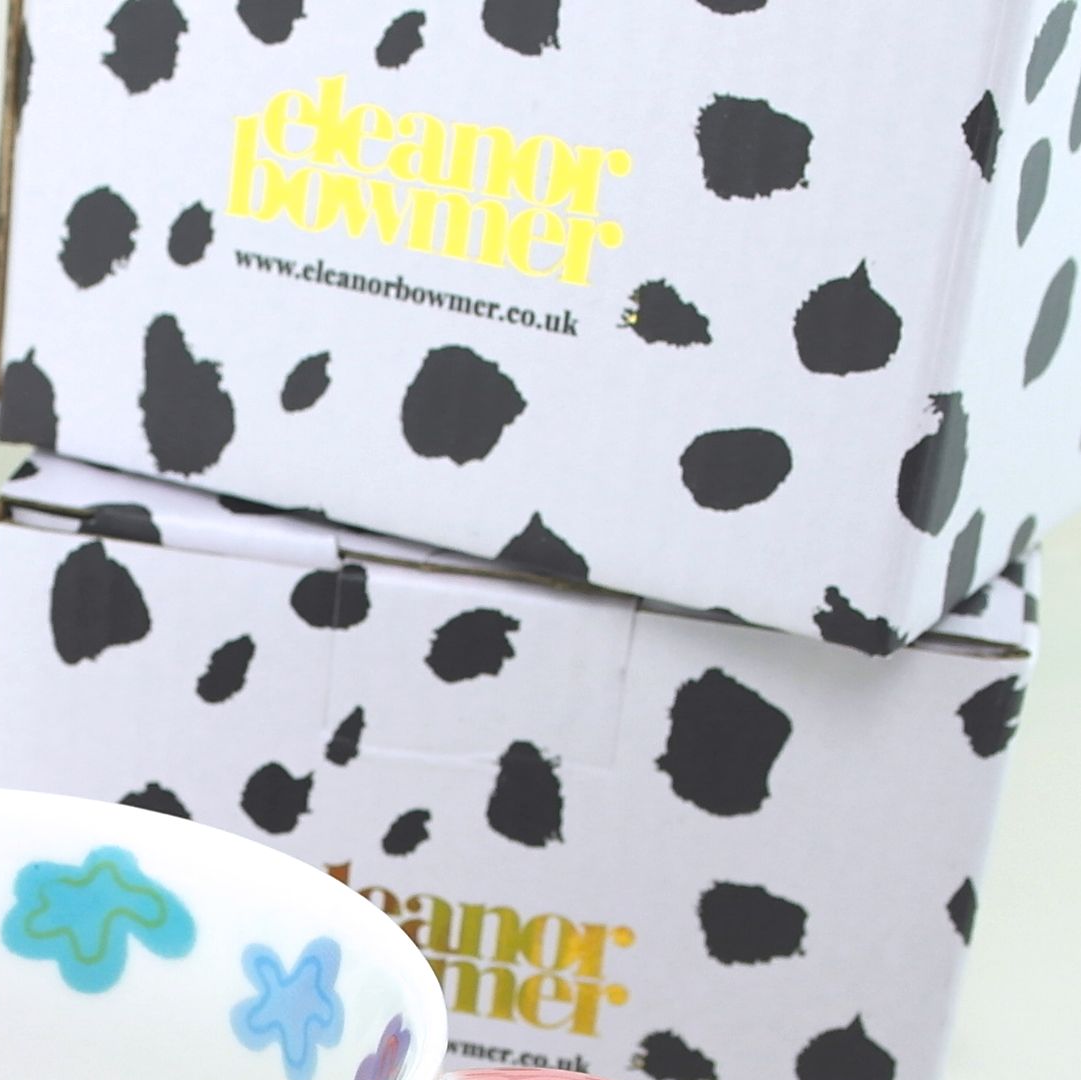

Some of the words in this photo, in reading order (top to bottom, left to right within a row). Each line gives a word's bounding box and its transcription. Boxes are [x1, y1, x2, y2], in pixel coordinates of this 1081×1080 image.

[226, 113, 624, 287] bowmer
[262, 74, 633, 217] eleanor
[234, 249, 579, 336] www.eleanorbowmer.co.uk
